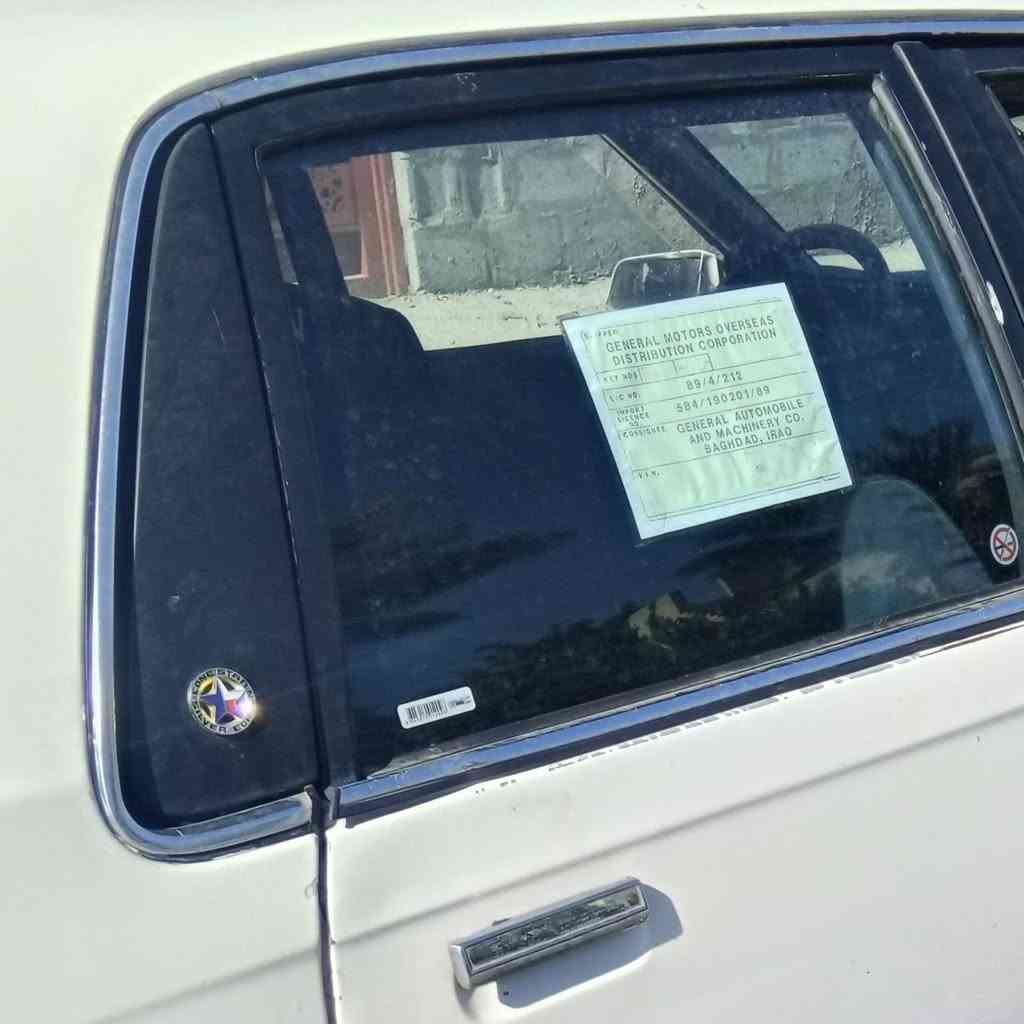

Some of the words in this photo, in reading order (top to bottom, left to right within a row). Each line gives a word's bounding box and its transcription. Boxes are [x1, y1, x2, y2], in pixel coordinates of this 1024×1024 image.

[605, 336, 661, 353] GENERAL
[663, 326, 713, 344] MOTORS
[715, 315, 775, 335] OVERSEAS
[612, 343, 694, 366] DISTRIBUTION
[698, 328, 777, 351] CORPORATION
[676, 414, 729, 434] GENERAL
[735, 399, 805, 422] AUTOMOBILE
[688, 431, 712, 445] AND
[715, 418, 779, 440] MACHINERY
[784, 412, 806, 425] CO.
[704, 436, 763, 454] BAGHDAD,
[766, 426, 793, 441] IRAQ
